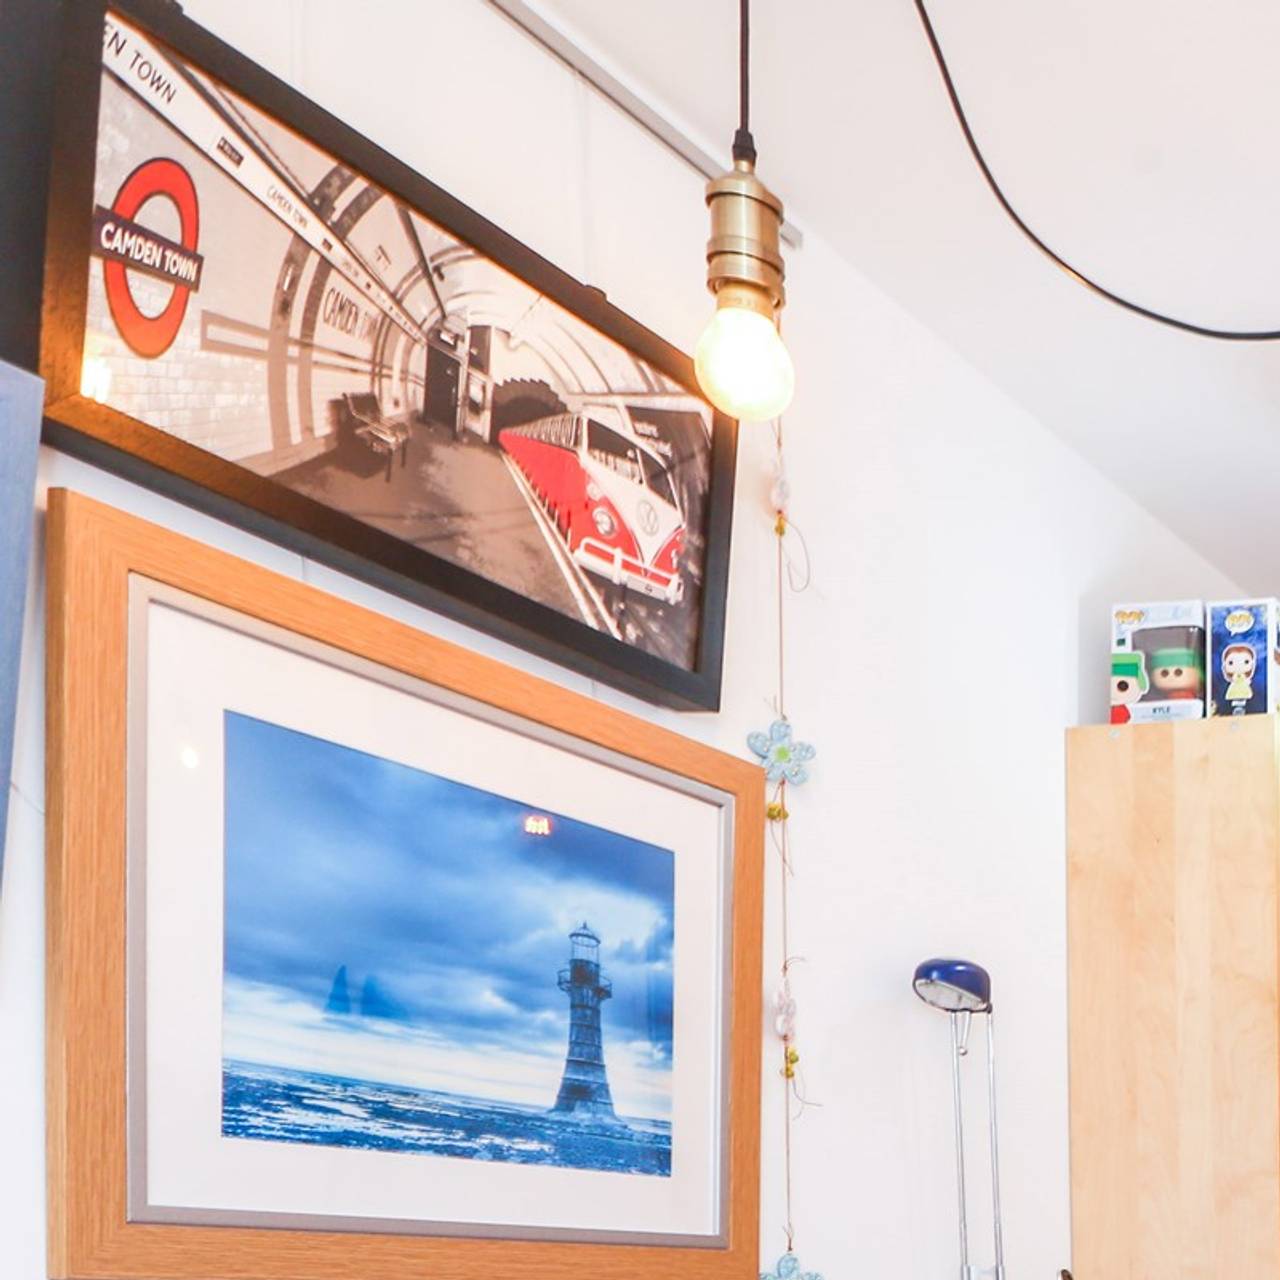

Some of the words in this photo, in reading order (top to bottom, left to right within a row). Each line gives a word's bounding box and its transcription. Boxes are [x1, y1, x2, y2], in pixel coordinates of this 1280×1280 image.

[128, 50, 177, 103] TOWN
[101, 222, 162, 270] CAMDEN
[163, 248, 198, 283] TOWN
